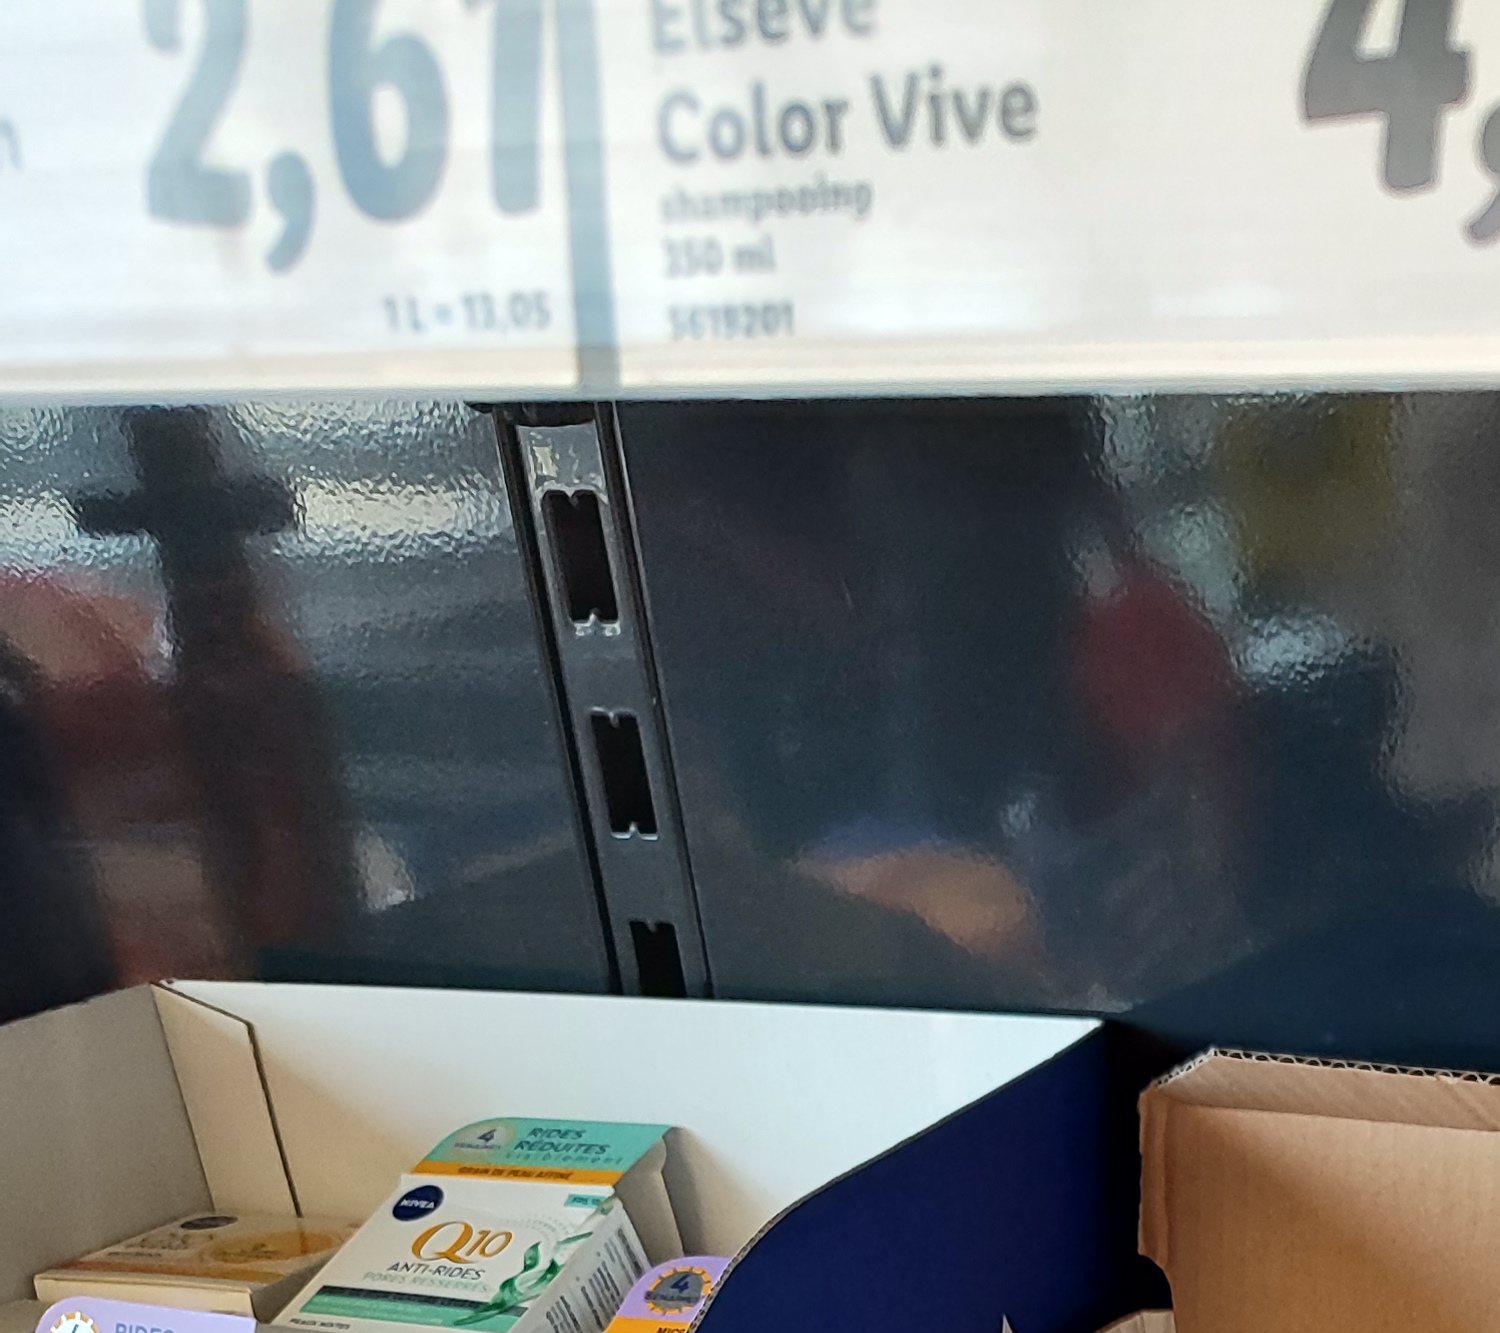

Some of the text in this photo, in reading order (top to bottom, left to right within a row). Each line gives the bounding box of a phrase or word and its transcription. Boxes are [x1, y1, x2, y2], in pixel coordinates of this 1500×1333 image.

[660, 66, 1041, 164] Color Vive
[527, 1127, 587, 1140] RIDES
[514, 1137, 611, 1155] RÉDUITES
[411, 1220, 513, 1264] Q10
[387, 1262, 486, 1281] ANTI-RIDES
[671, 1274, 690, 1293] 4
